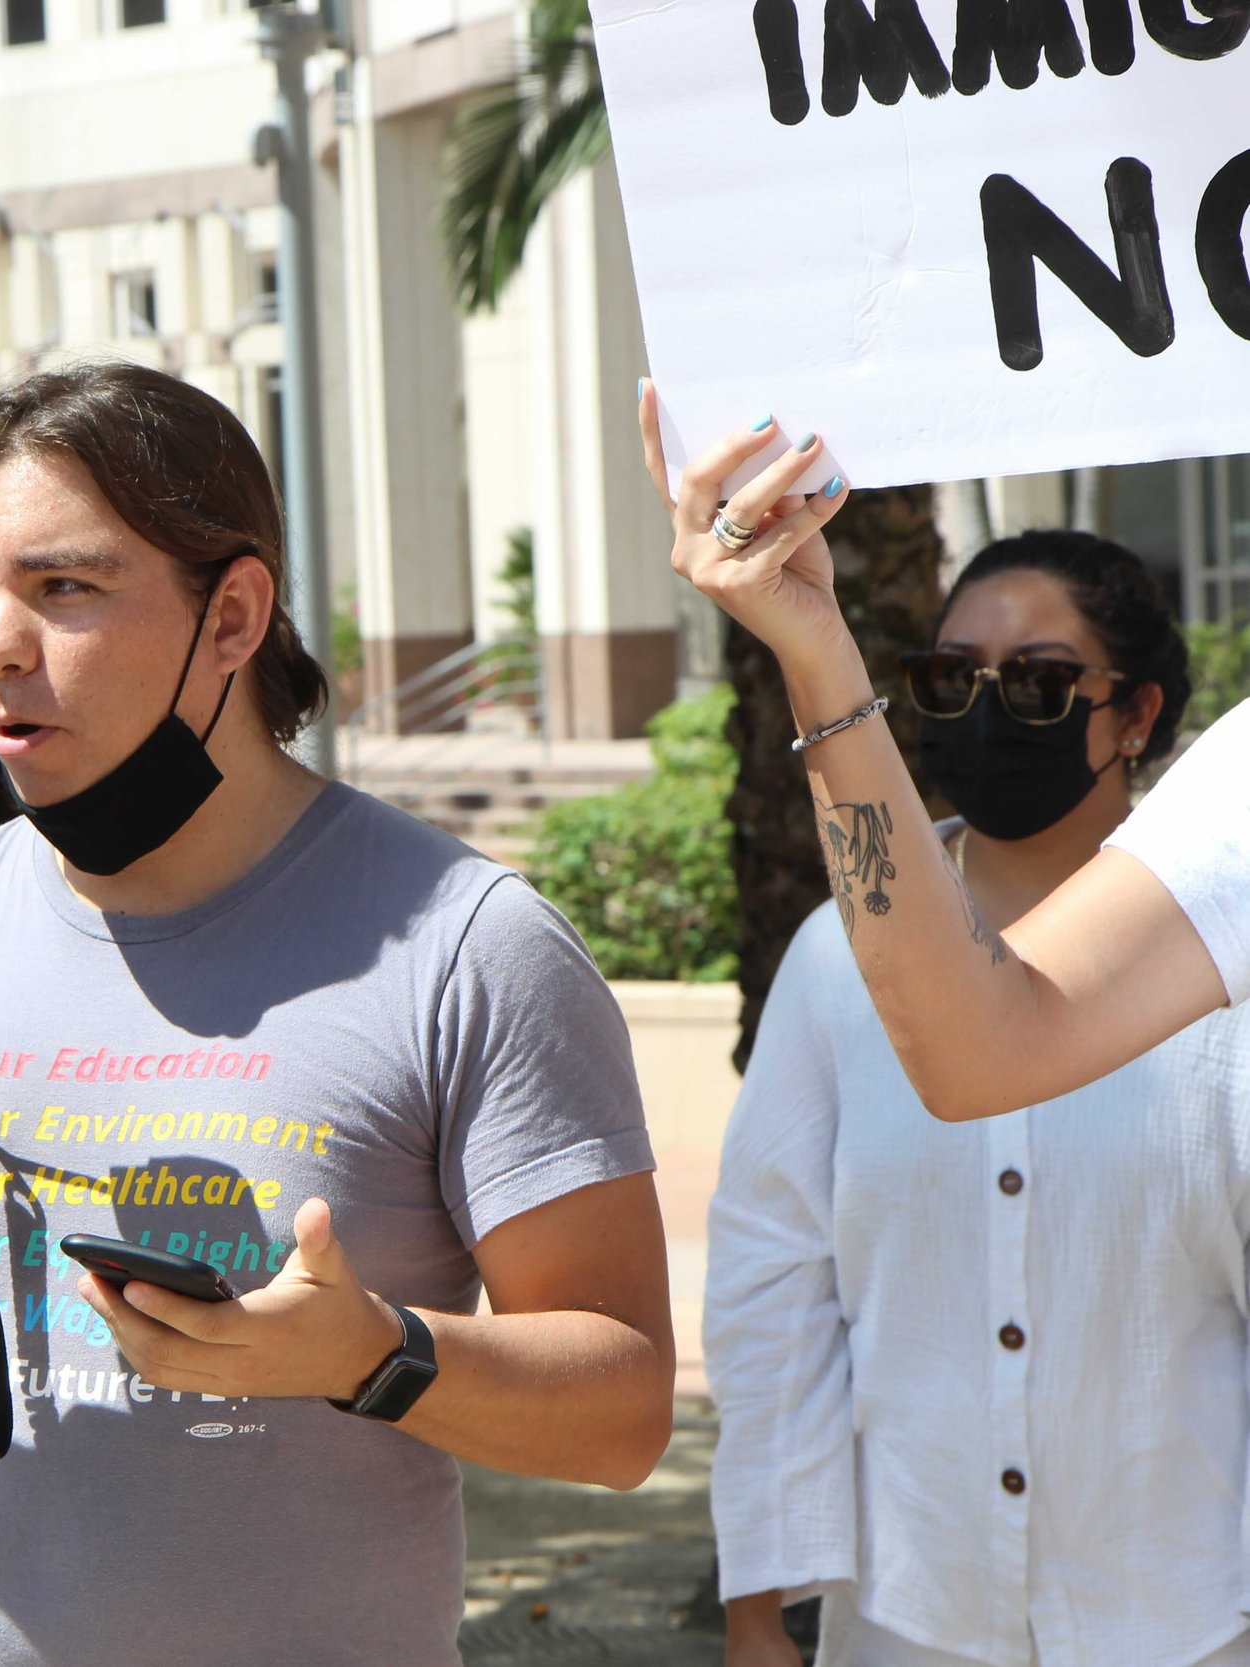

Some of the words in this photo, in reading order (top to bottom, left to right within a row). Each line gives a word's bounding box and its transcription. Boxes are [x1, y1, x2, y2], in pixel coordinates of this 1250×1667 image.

[46, 1043, 274, 1084] Education
[34, 1104, 335, 1155] Environment
[28, 1166, 282, 1210] Healthcare
[9, 1357, 156, 1403] Future
[238, 1423, 266, 1434] 267-C
